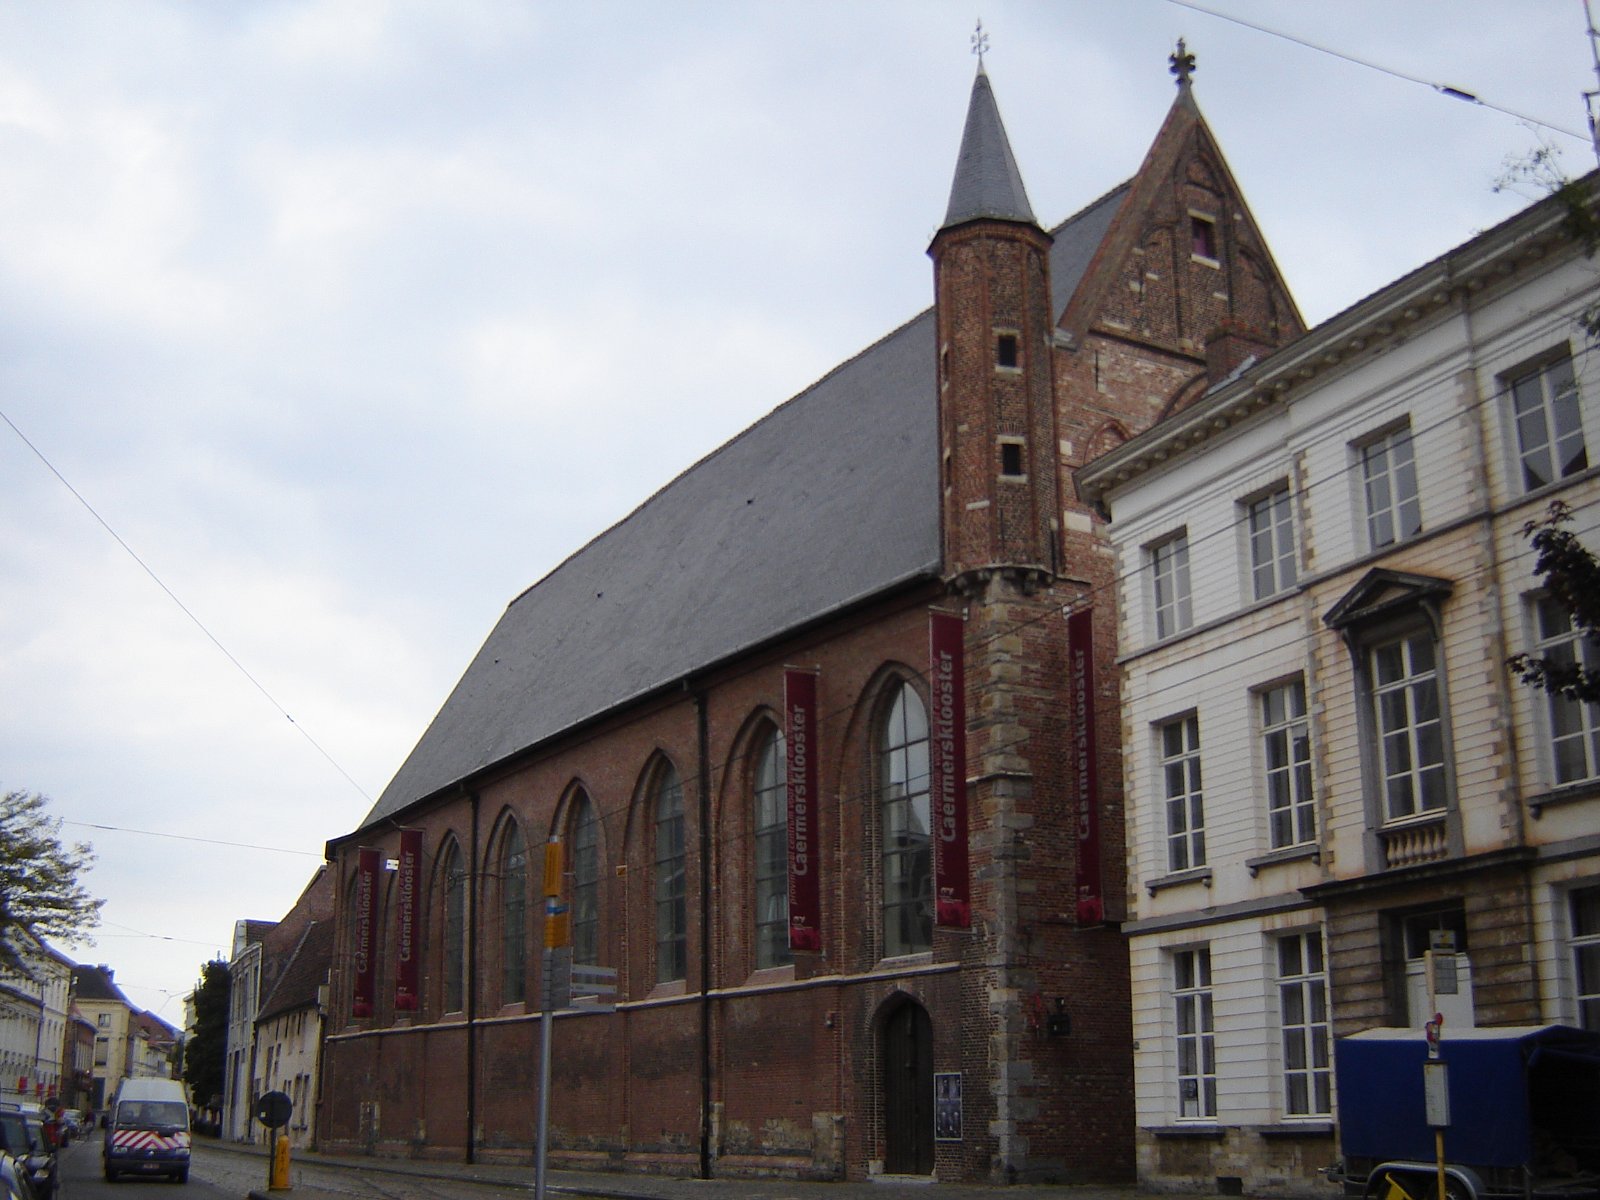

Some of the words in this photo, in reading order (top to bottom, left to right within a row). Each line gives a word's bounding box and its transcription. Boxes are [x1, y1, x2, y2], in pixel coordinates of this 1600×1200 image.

[791, 704, 808, 876] Caermersklooster
[937, 650, 956, 842] Caermersklooster
[1074, 648, 1091, 840] Caermersklooster
[400, 850, 415, 962] Caermersklooster
